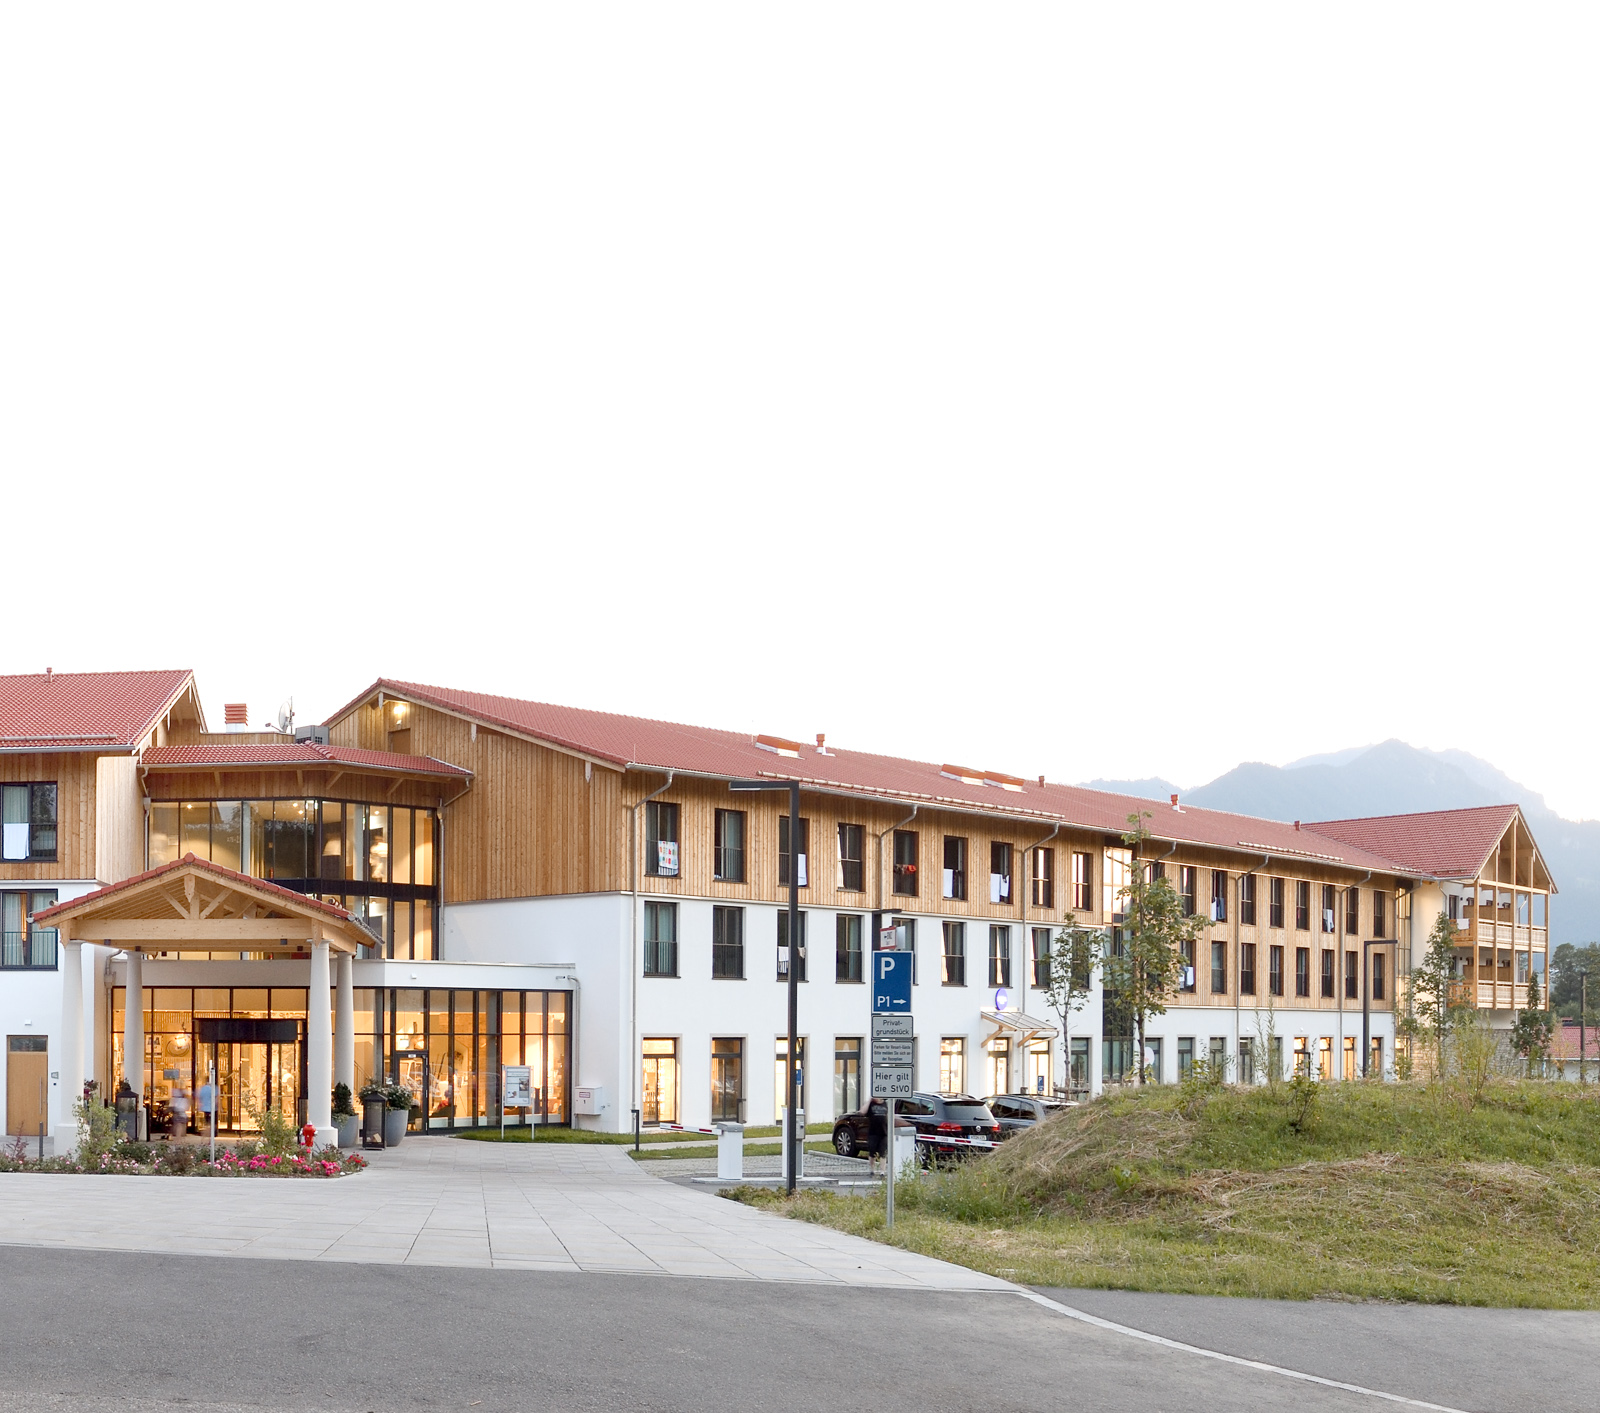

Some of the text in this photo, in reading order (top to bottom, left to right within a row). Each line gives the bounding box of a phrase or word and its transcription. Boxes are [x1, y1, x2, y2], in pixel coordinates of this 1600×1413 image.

[880, 957, 896, 980] P
[877, 995, 890, 1007] P1
[875, 1028, 910, 1036] grundstück
[875, 1072, 909, 1082] Hier gilt
[874, 1084, 910, 1093] die StVO
